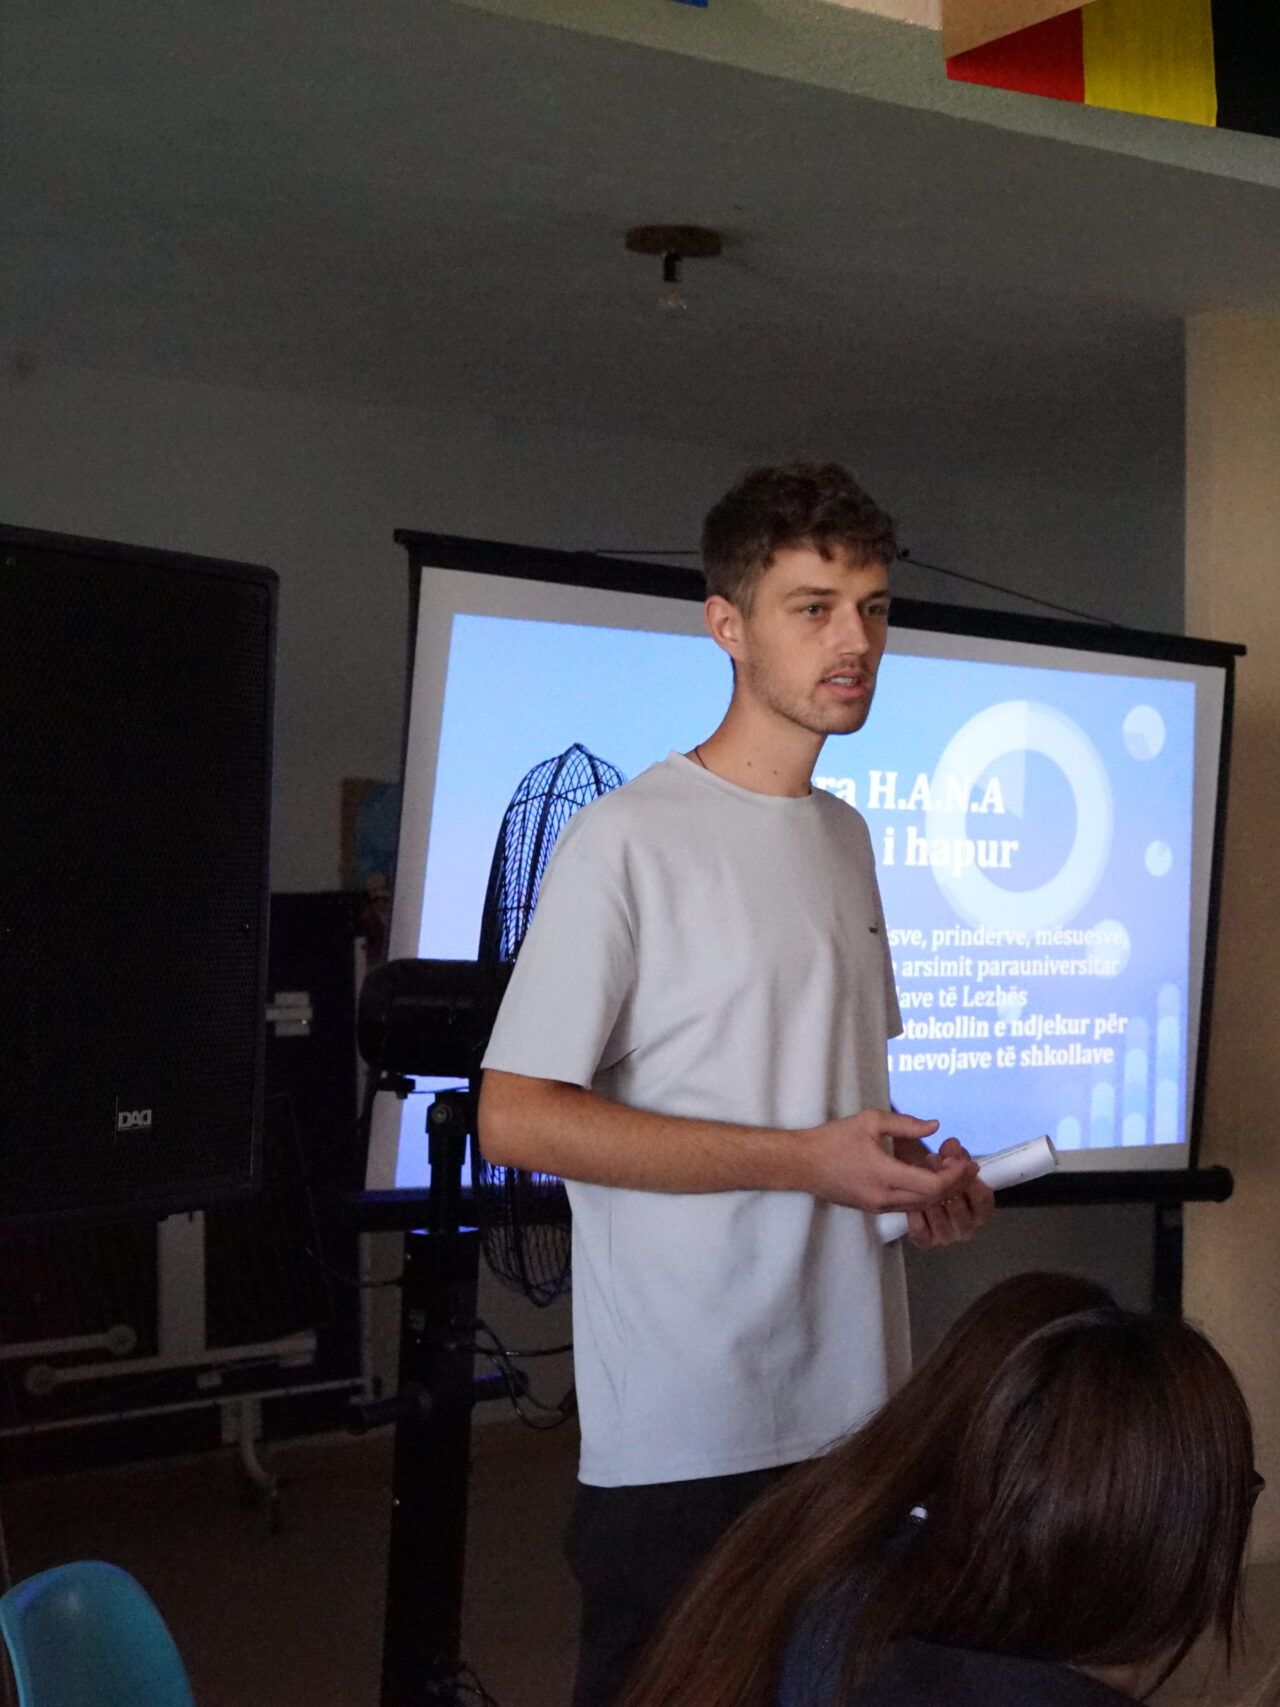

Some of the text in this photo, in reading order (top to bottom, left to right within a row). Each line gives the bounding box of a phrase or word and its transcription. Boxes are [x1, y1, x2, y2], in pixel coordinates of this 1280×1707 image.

[867, 770, 1006, 814] H.A.N.A
[883, 826, 1019, 877] i hapur
[931, 925, 1031, 952] prindërve,
[902, 957, 973, 977] arsimit
[978, 956, 1118, 982] parauniversitar
[939, 987, 957, 1007] të
[963, 985, 1027, 1007] Lezhës
[994, 1021, 1006, 1036] e
[1011, 1015, 1090, 1039] ndjekur
[1094, 1014, 1128, 1039] për
[899, 1048, 991, 1074] nevojave
[997, 1047, 1016, 1067] të
[1020, 1043, 1114, 1067] shkollave
